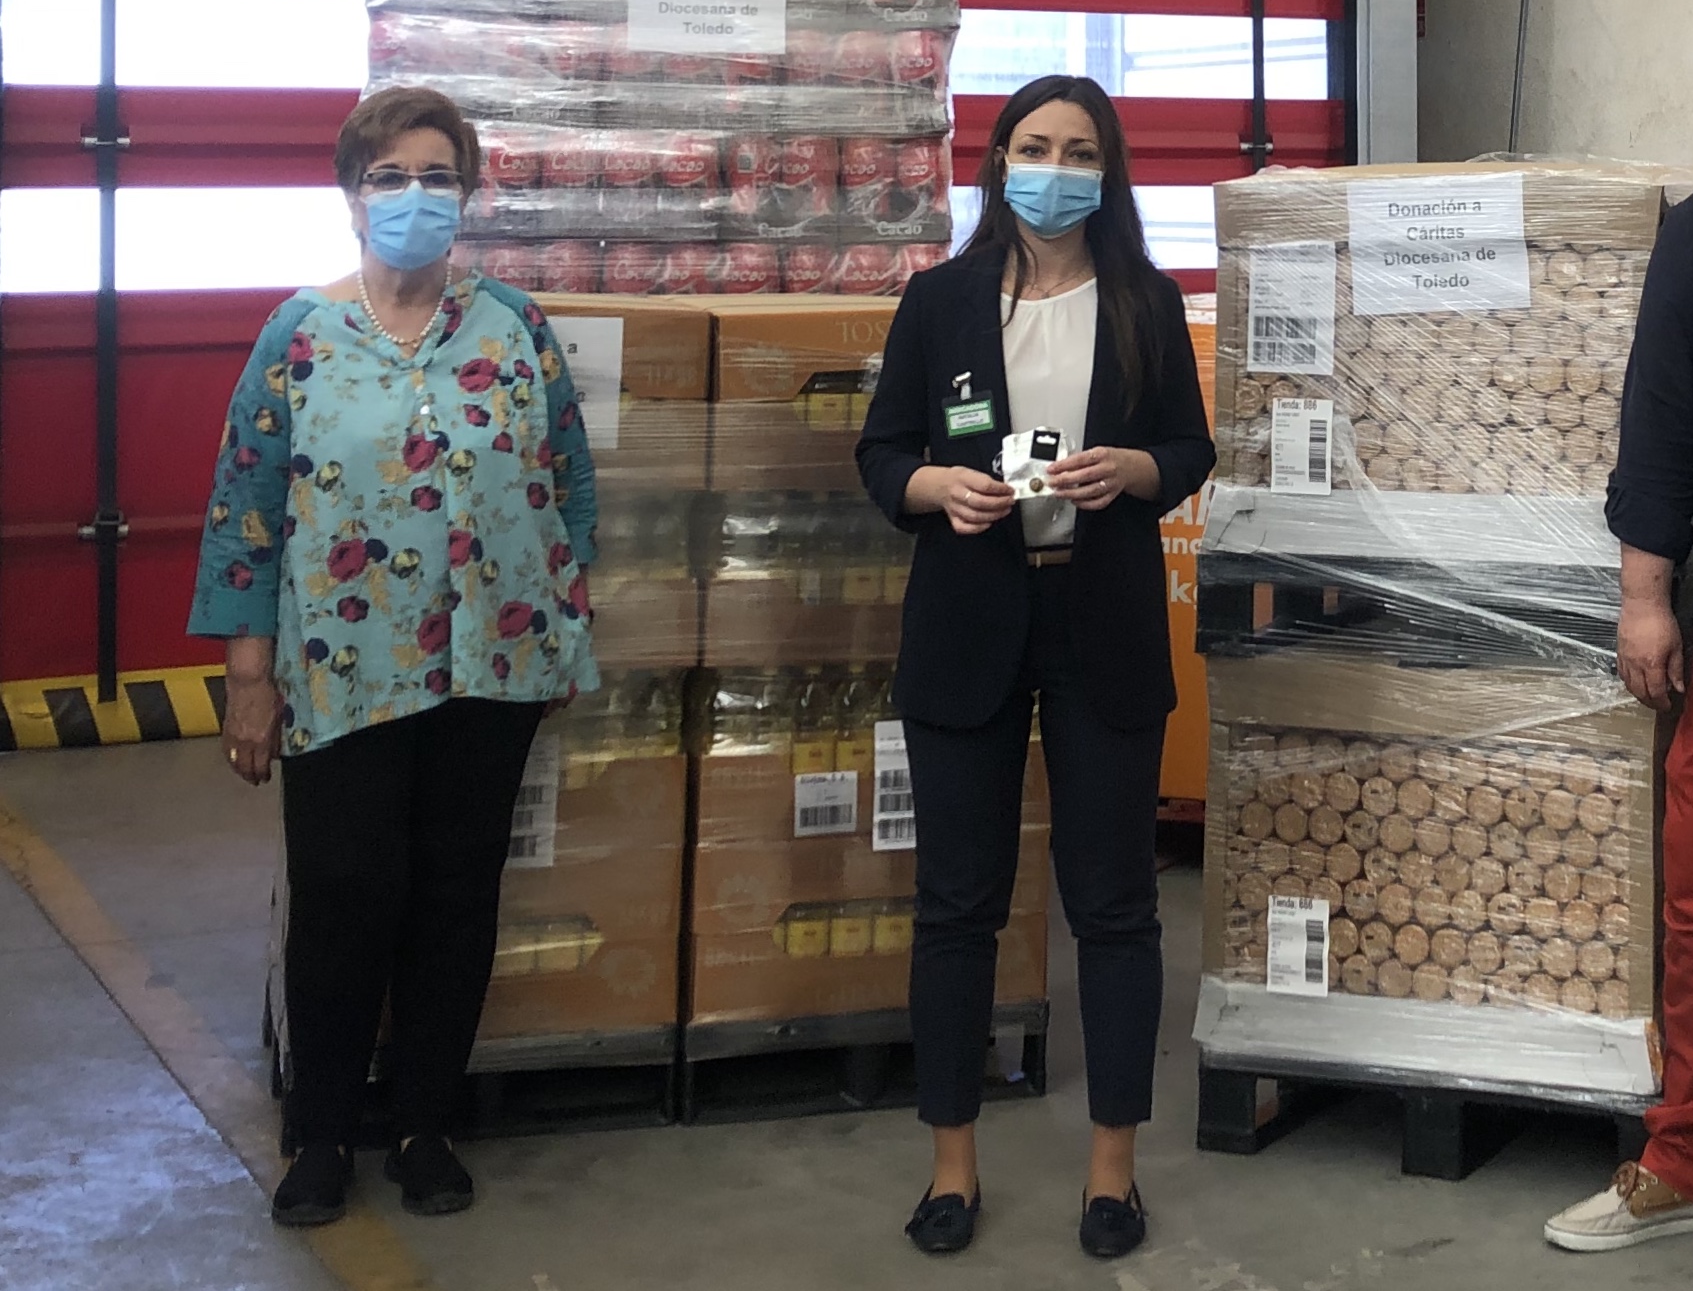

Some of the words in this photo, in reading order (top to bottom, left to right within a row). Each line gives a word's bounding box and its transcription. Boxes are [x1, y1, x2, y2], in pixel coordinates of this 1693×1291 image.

[658, 1, 737, 16] Diocesana
[740, 3, 758, 16] de
[884, 7, 928, 22] Cacao
[683, 22, 734, 36] Toledo
[1388, 198, 1467, 218] Donación
[1472, 201, 1482, 212] a
[875, 221, 923, 236] Cacao
[1406, 225, 1465, 241] Cáritas
[1384, 249, 1470, 266] Diocesana
[1475, 247, 1496, 261] de
[1412, 273, 1470, 289] Toledo
[567, 341, 578, 355] a
